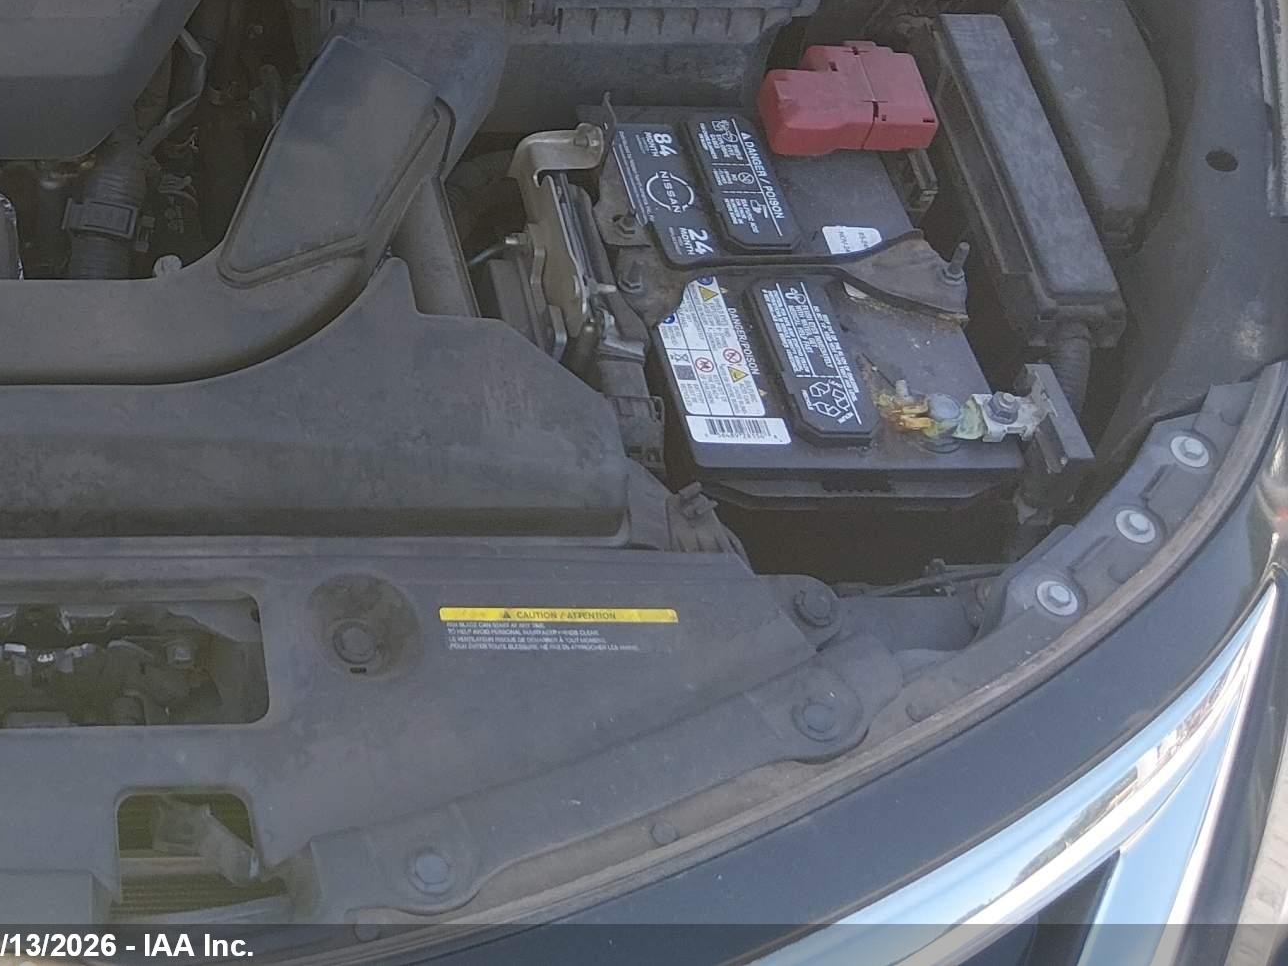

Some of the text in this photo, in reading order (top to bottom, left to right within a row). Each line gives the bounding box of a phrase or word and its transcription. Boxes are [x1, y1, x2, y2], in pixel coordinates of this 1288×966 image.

[644, 132, 660, 157] MONTH
[654, 133, 678, 156] 84
[659, 171, 681, 213] NISSAN
[745, 142, 767, 176] DANGER
[763, 186, 785, 218] POISON
[679, 227, 695, 255] MONTH
[688, 228, 714, 254] 24
[728, 308, 761, 375] DANGER/POISON
[516, 611, 557, 619] CAUTION
